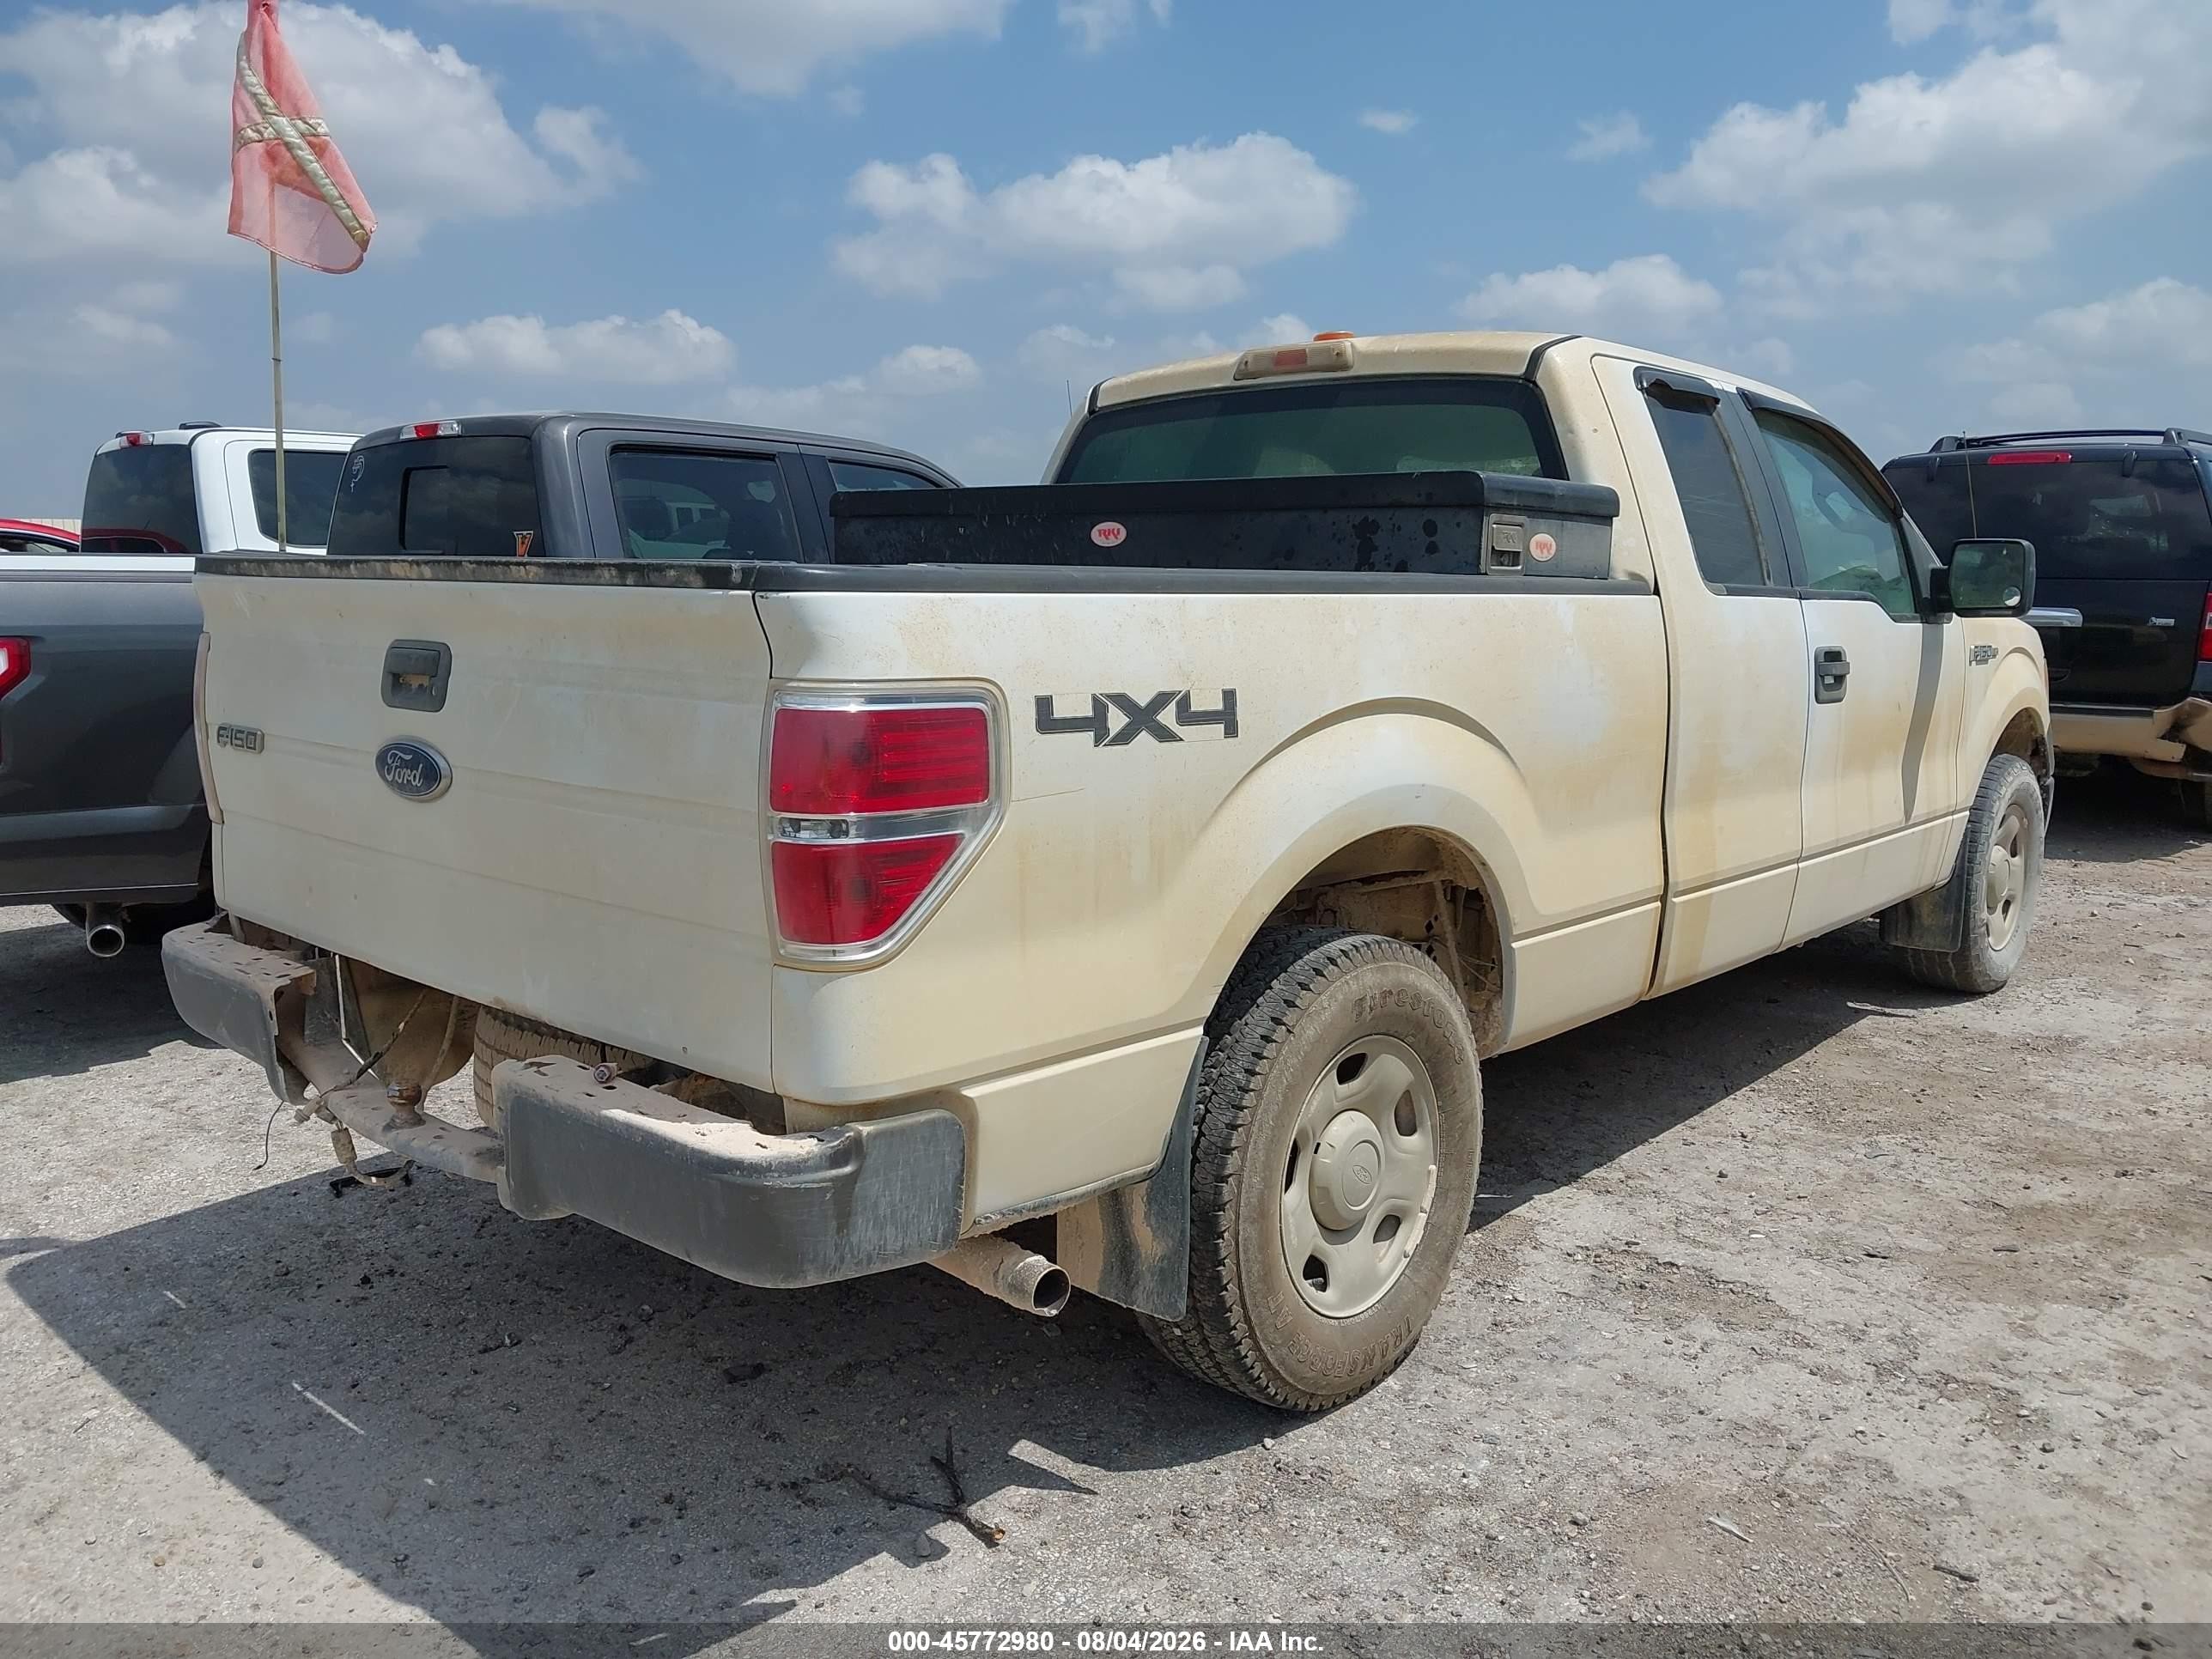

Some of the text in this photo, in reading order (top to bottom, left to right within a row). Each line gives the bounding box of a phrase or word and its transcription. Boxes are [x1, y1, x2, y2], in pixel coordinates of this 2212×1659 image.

[1034, 688, 1239, 747] 4X4
[384, 750, 424, 787] Ford
[1352, 988, 1465, 1066] Firestone
[1287, 1314, 1414, 1378] TRANSFORCE
